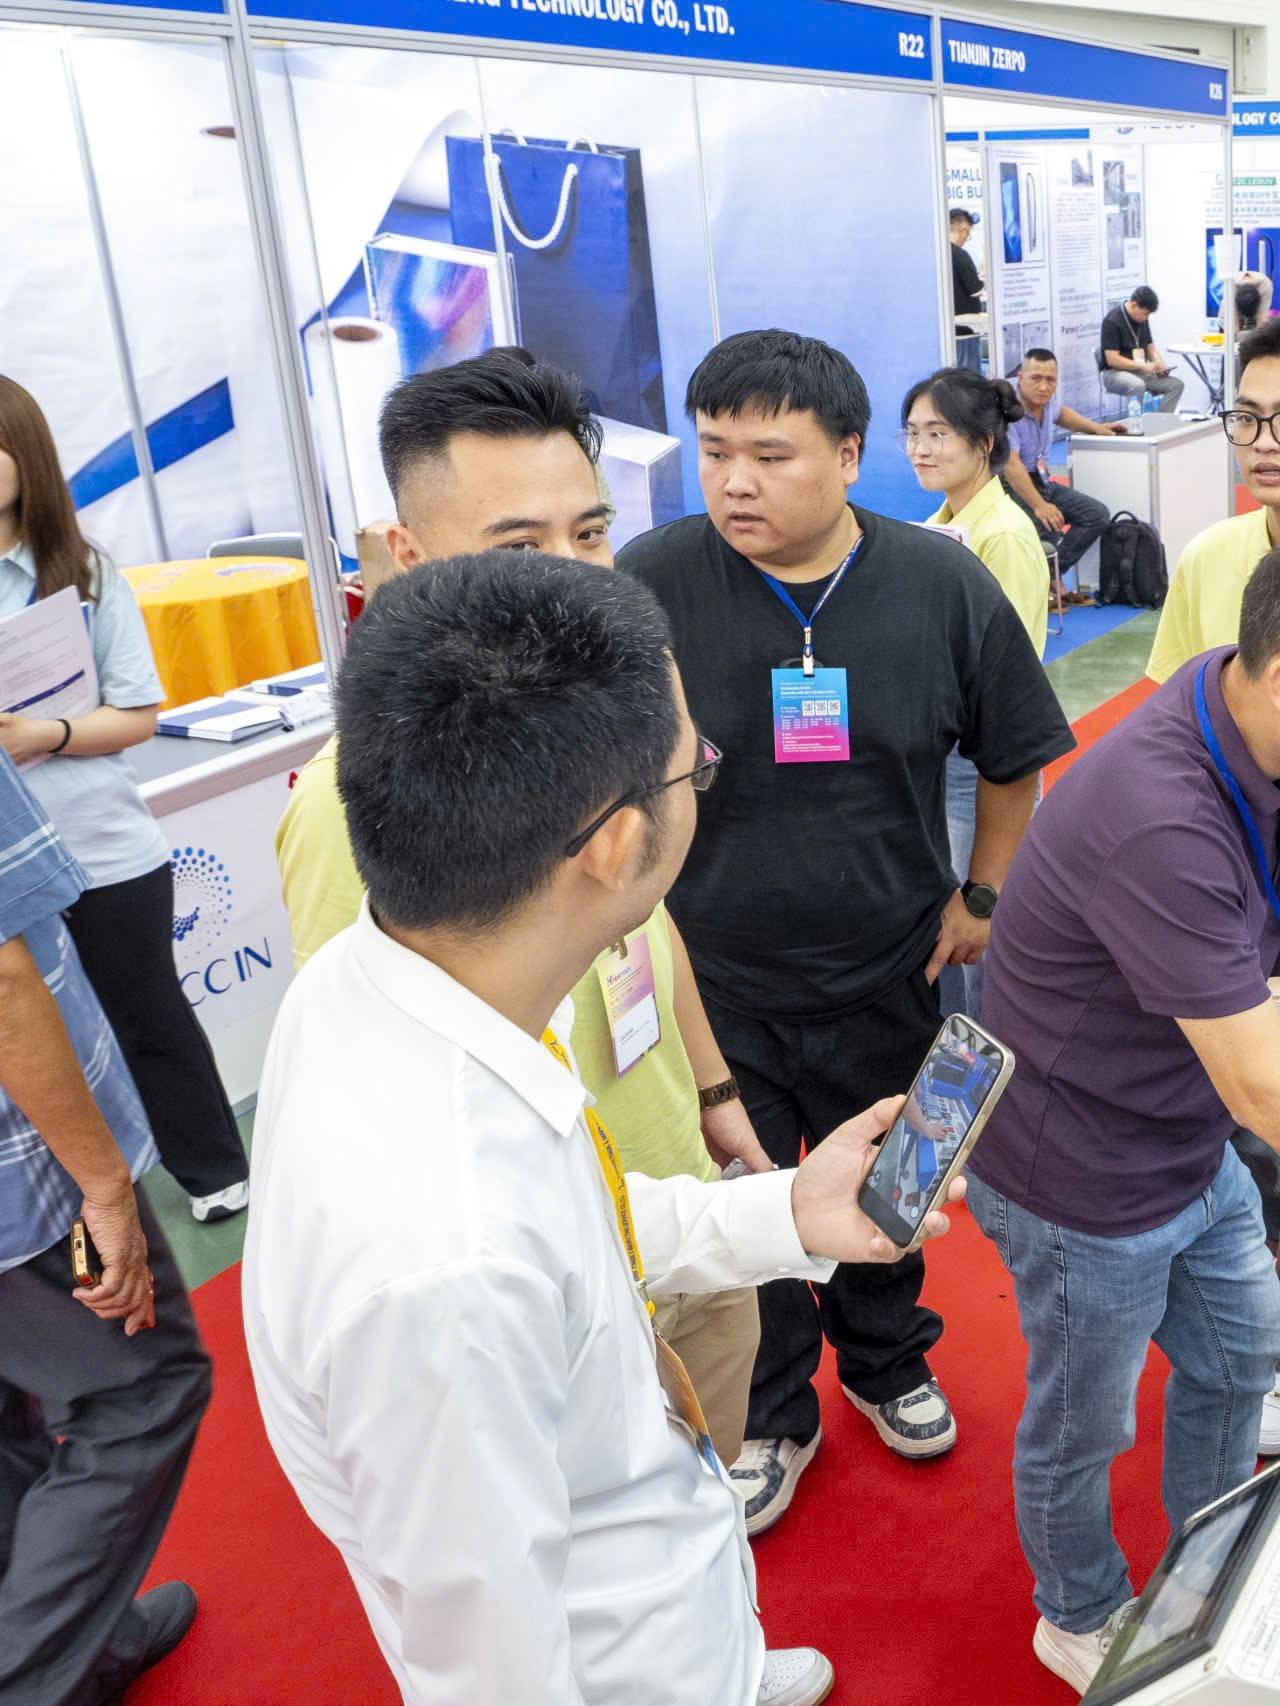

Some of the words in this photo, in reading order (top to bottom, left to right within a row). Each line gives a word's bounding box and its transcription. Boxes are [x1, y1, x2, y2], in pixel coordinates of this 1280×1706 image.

[651, 0, 690, 35] CO.,
[694, 6, 736, 35] LTD.
[898, 32, 925, 59] R22
[948, 39, 990, 68] TIANJIN
[991, 47, 1026, 73] ZERPO
[945, 168, 982, 181] SMALL
